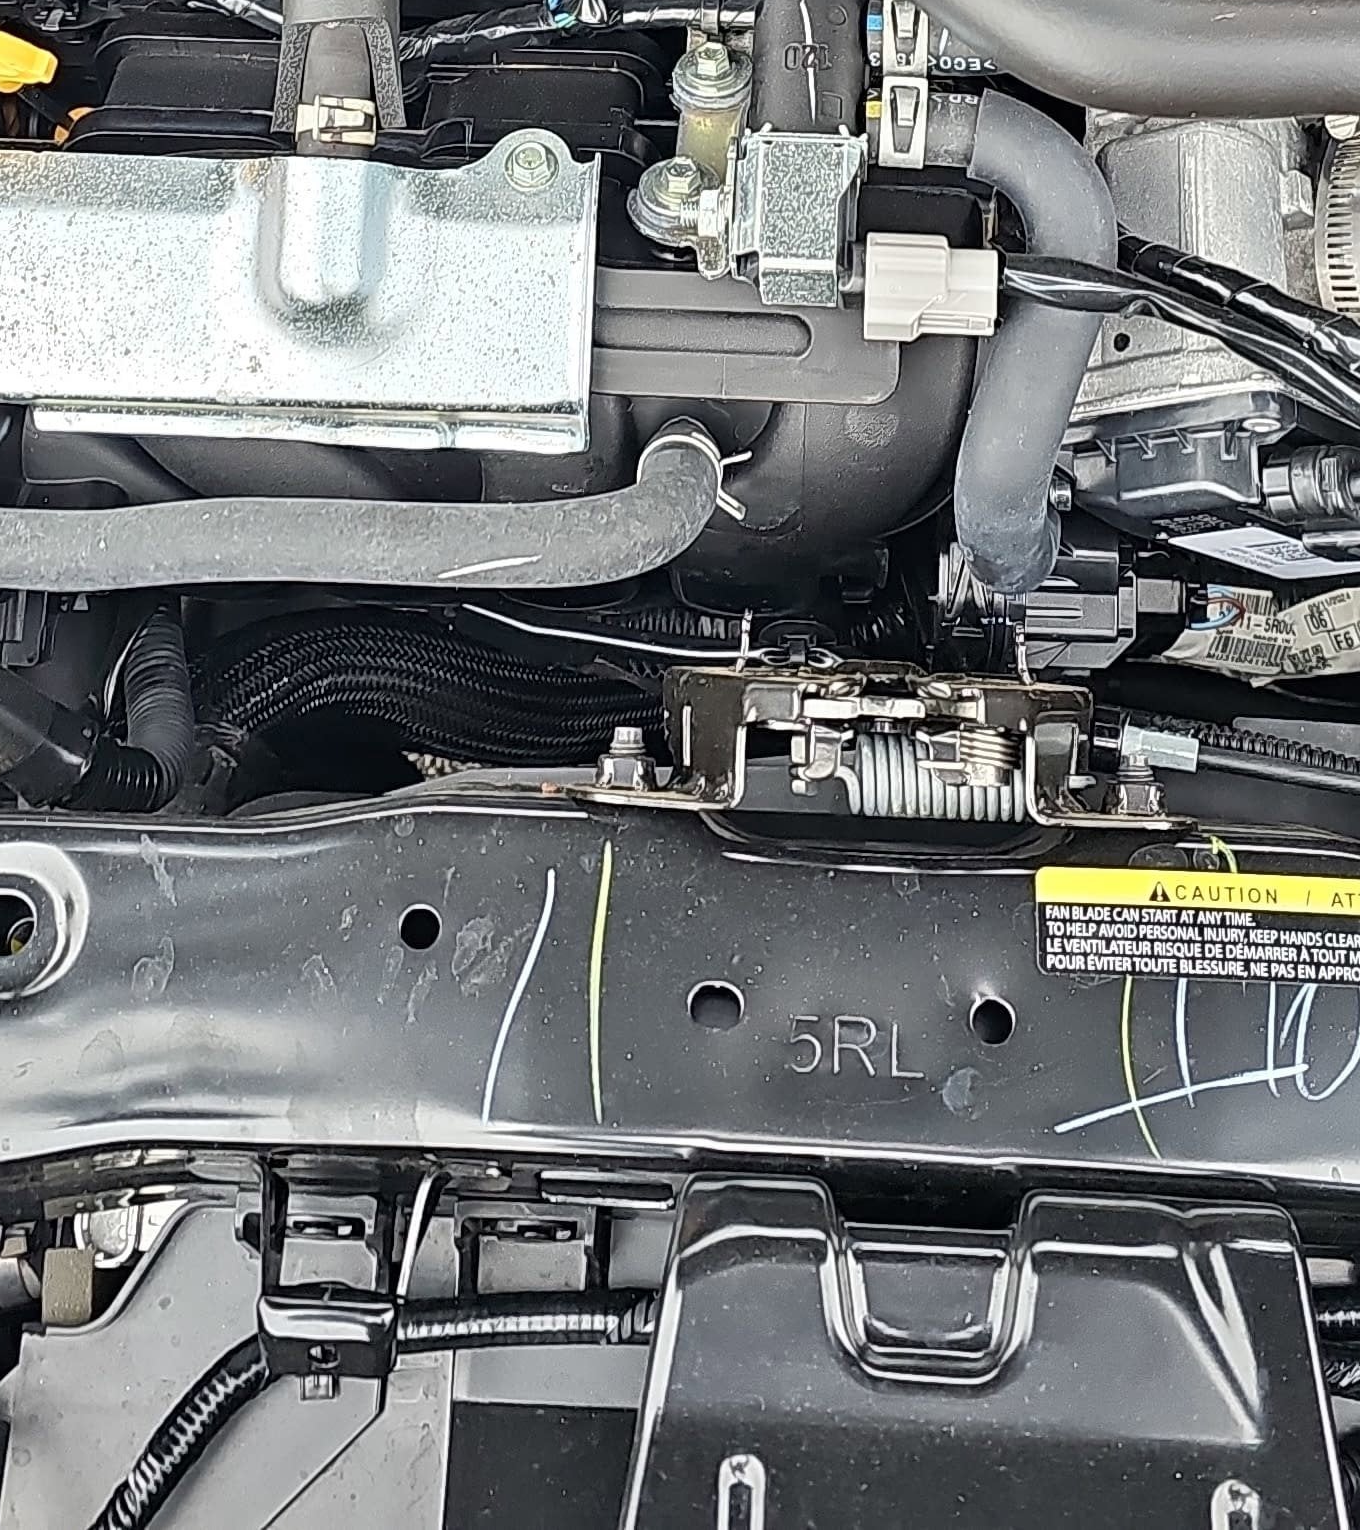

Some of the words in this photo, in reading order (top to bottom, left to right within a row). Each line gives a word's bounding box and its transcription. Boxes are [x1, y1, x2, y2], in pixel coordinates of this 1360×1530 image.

[1174, 883, 1279, 905] CAUTION
[1045, 904, 1071, 920] FAN
[1071, 906, 1112, 922] BLADE
[1113, 908, 1140, 923] CAN
[1141, 909, 1177, 924] START
[1179, 910, 1195, 924] AT
[1197, 911, 1223, 926] ANY
[1223, 911, 1256, 927] TIME.
[1046, 921, 1065, 936] TO
[1066, 922, 1097, 937] HELP
[1098, 923, 1138, 939] AVOID
[1139, 925, 1202, 941] PERSONAL
[1203, 927, 1247, 944] INJURY,
[1249, 929, 1279, 944] KEEP
[1280, 931, 1323, 947] HANDS
[1046, 938, 1062, 953] LE
[1063, 938, 1152, 956] VENTILATEUR
[1153, 942, 1202, 959] RISQUE
[1205, 944, 1222, 958] DE
[1225, 942, 1297, 962] DÉMARRER
[1299, 945, 1311, 962] À
[1310, 948, 1346, 964] TOUT
[1046, 954, 1086, 970] POUR
[1087, 952, 1132, 972] ÉVITER
[1132, 958, 1177, 974] TOUTE
[1179, 959, 1248, 978] BLESSURE,
[1250, 962, 1268, 977] NE
[1270, 963, 1296, 979] PAS
[1298, 964, 1316, 980] EN
[789, 1013, 927, 1083] 5RL
